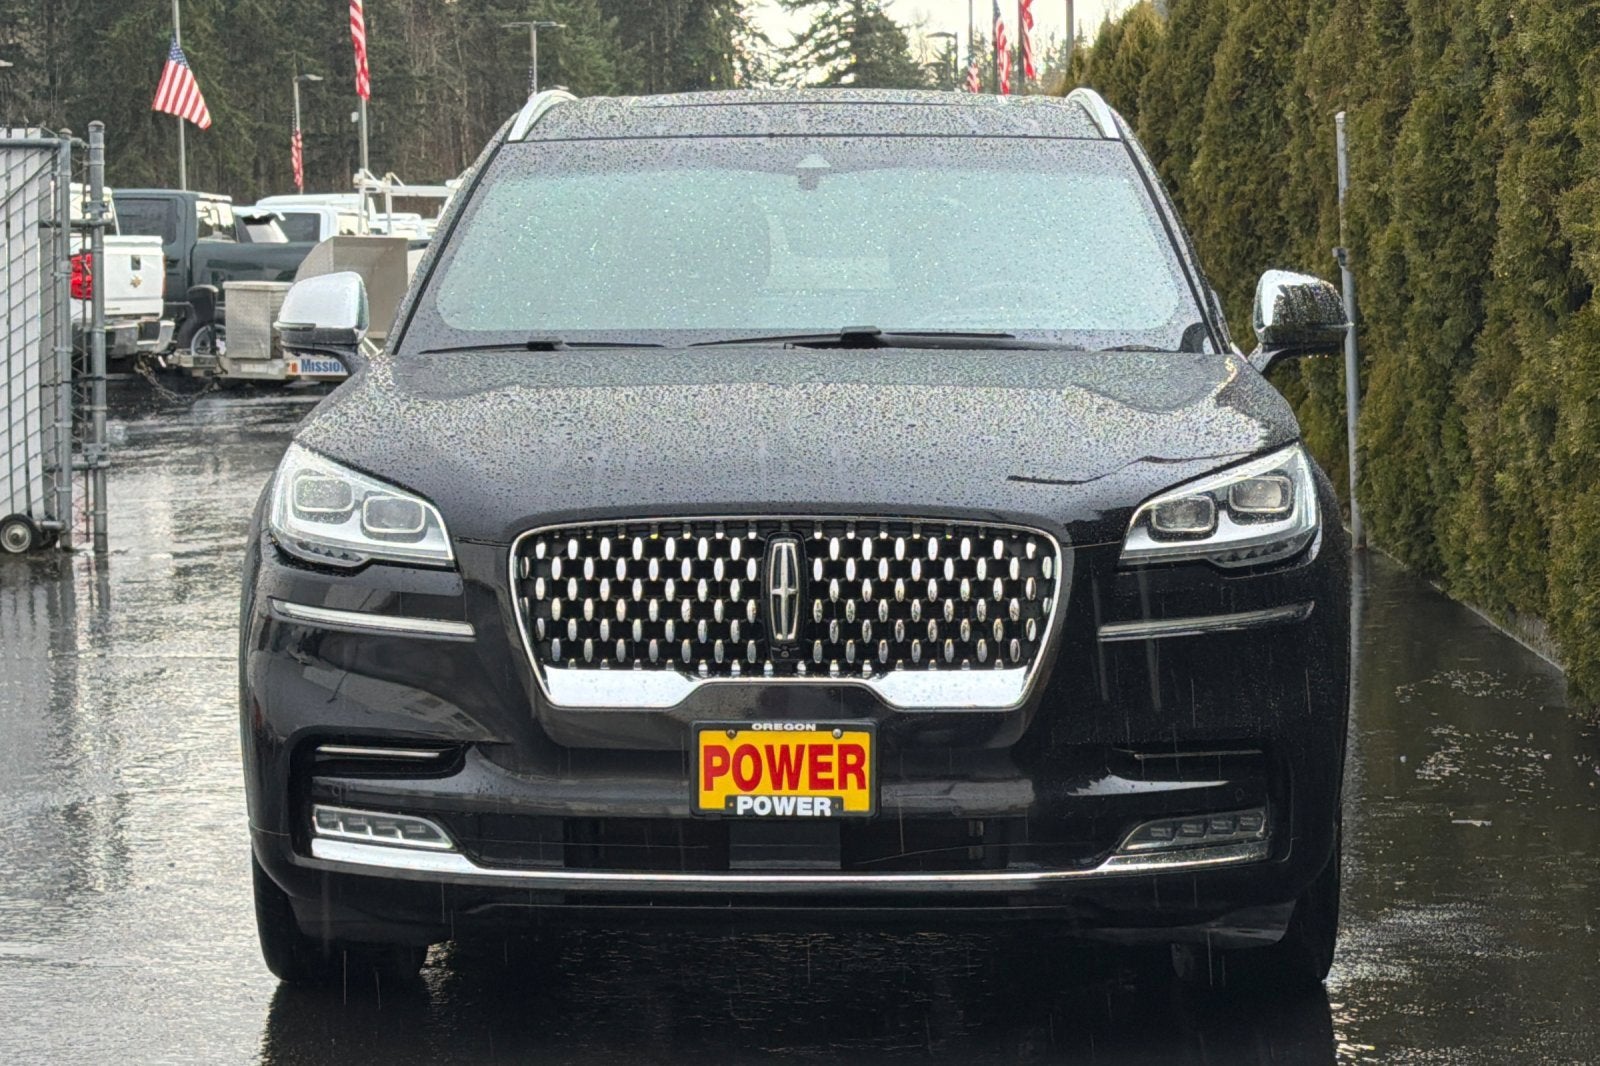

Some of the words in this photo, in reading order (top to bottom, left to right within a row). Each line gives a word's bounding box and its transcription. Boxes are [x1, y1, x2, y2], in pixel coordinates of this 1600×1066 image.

[751, 723, 817, 732] OREGON
[703, 743, 867, 792] POWER
[736, 795, 832, 817] POWER
